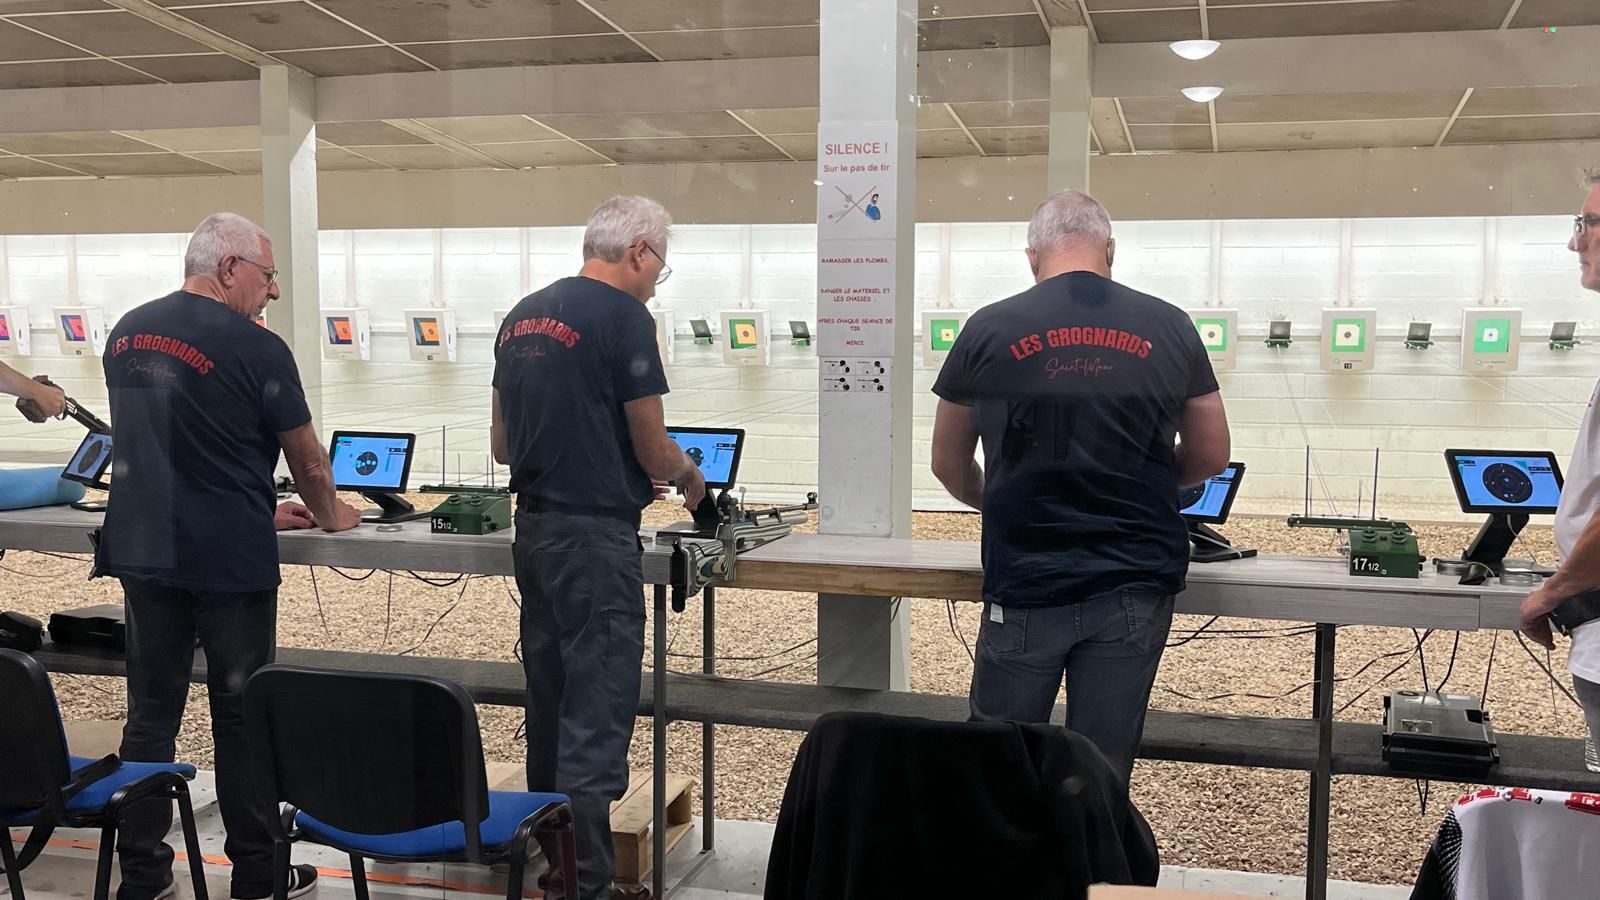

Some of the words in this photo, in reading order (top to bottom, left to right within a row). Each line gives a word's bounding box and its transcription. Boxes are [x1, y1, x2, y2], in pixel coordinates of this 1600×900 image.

[825, 142, 880, 155] SILENCE
[823, 164, 838, 173] Sur
[840, 164, 848, 172] le
[850, 164, 865, 173] pas
[867, 163, 878, 172] de
[880, 163, 890, 172] tir
[513, 317, 581, 348] GROGNARDS
[1010, 333, 1044, 361] LES
[1046, 326, 1153, 359] GROGNARDS
[111, 335, 129, 357] LES
[133, 333, 215, 375] GROGNARDS
